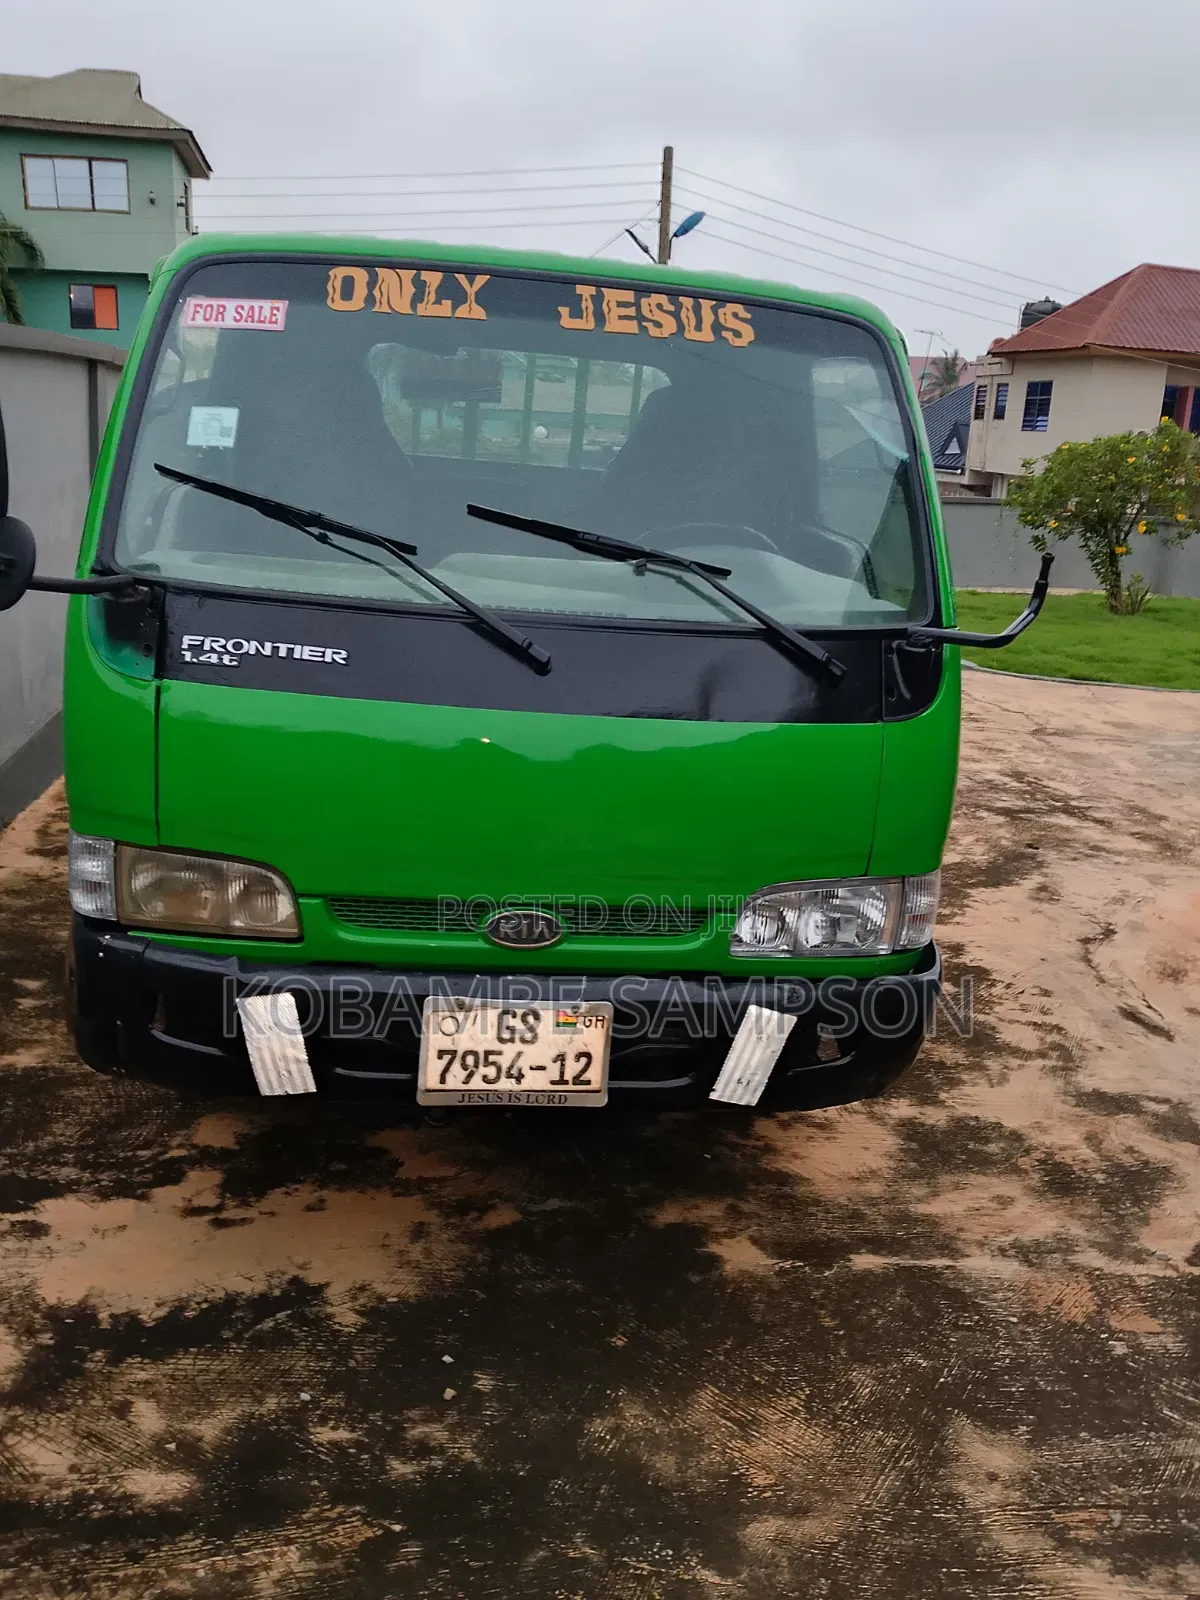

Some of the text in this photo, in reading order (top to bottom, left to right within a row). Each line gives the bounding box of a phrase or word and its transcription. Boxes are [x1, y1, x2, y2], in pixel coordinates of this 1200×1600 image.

[190, 303, 281, 325] FOR SALE
[326, 266, 755, 347] ONLY JESUS
[181, 635, 349, 665] FRONTIER
[499, 919, 550, 939] KIA
[496, 1009, 542, 1045] GS
[436, 1049, 593, 1086] 7954-12
[458, 1092, 503, 1104] JESUS
[508, 1092, 521, 1104] IS
